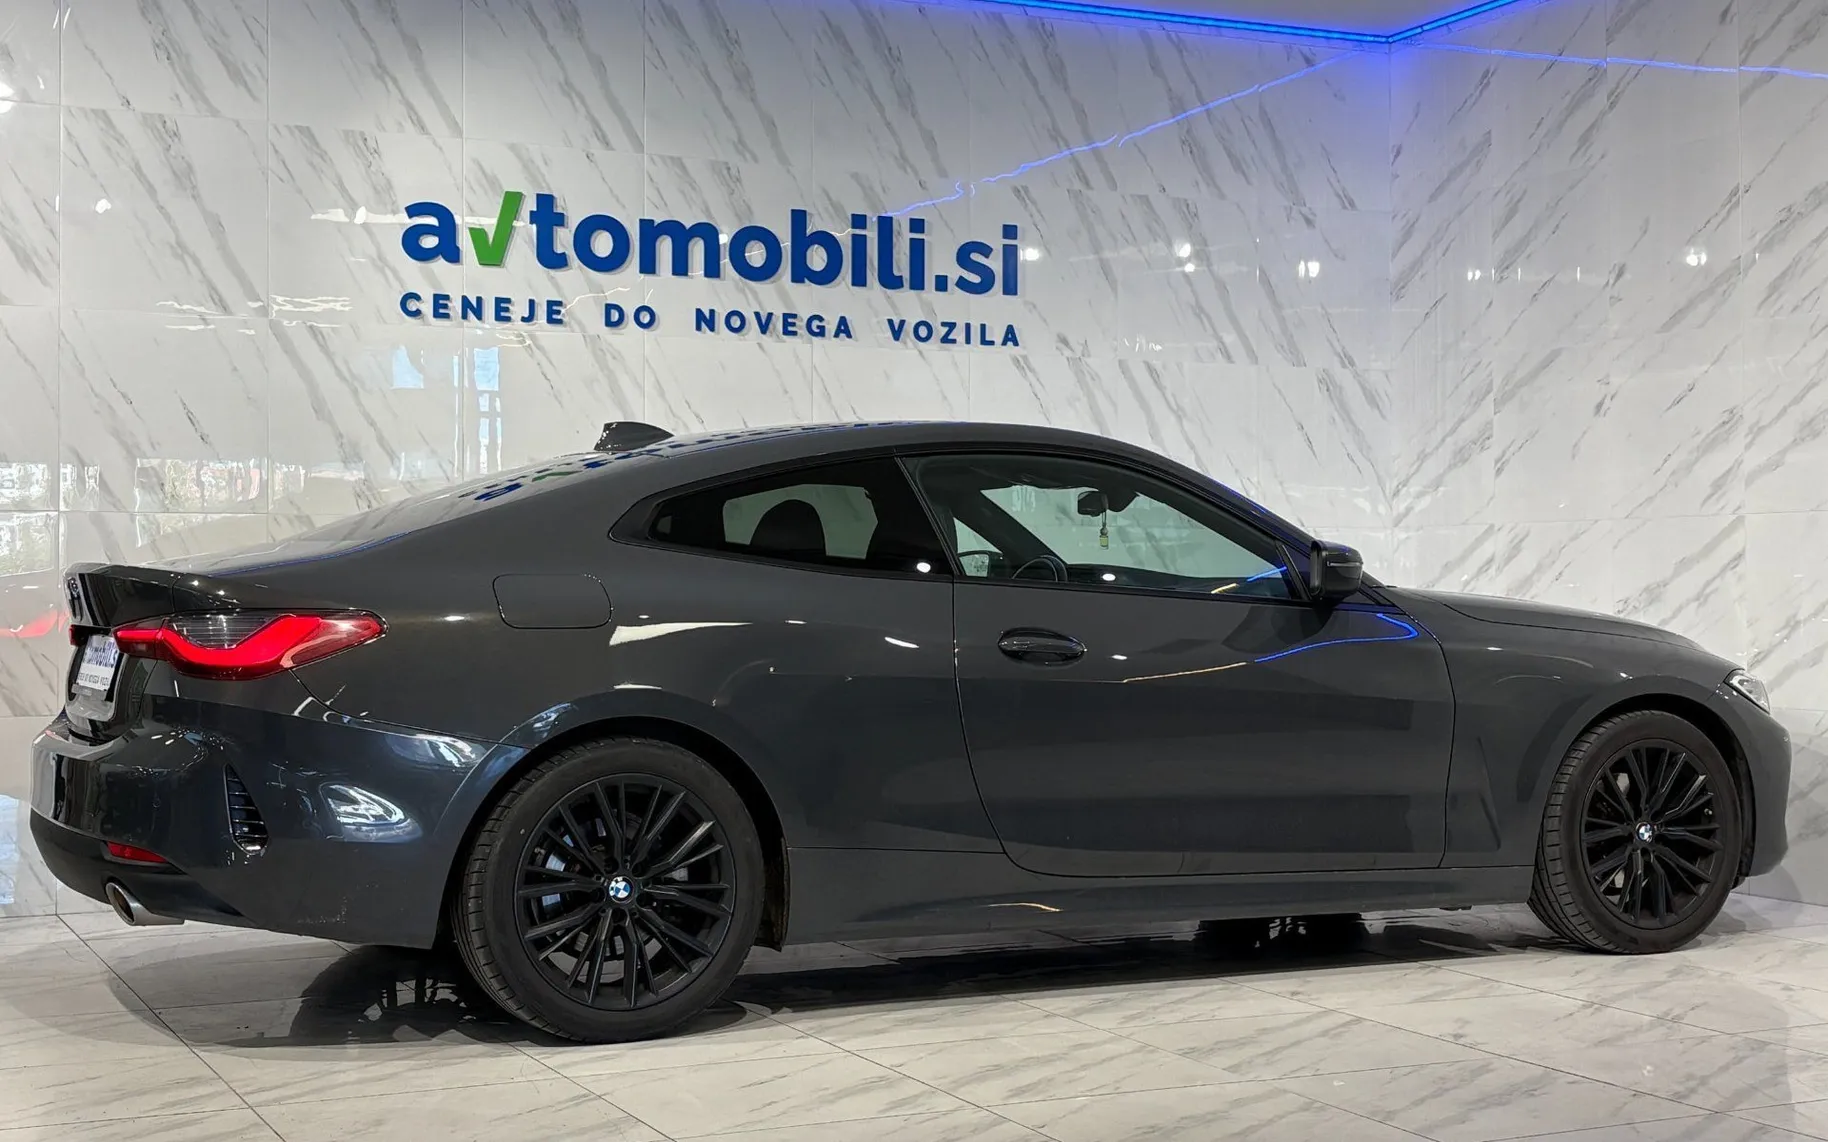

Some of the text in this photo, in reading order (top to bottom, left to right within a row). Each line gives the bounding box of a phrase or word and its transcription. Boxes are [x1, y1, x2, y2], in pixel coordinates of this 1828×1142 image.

[400, 292, 1020, 347] CENEJE DO NOVEGA VOZILA
